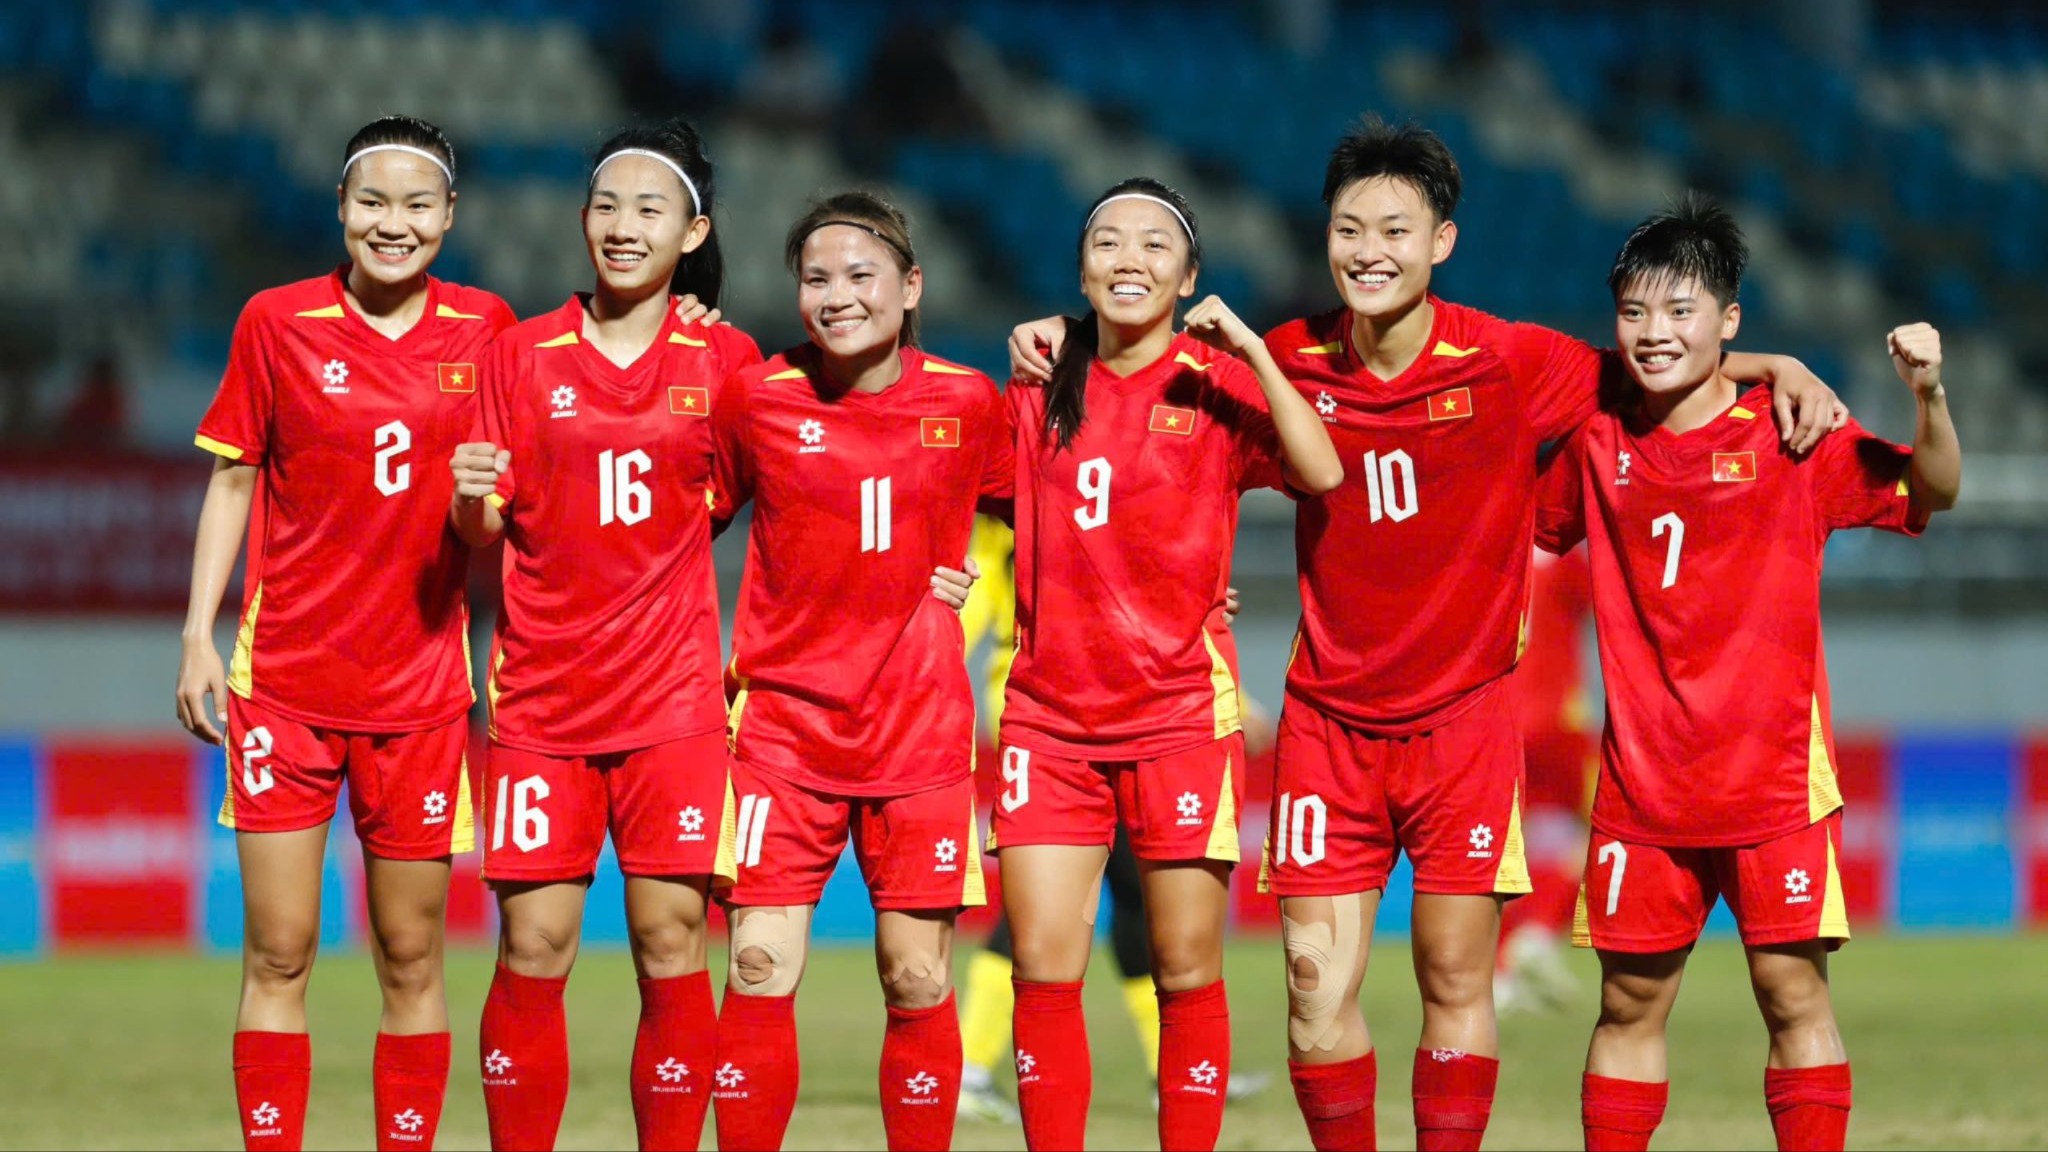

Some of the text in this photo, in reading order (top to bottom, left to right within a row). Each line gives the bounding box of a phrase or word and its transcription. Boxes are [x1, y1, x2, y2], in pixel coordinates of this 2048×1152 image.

[374, 419, 411, 497] 2
[598, 449, 652, 526] 16
[1073, 456, 1113, 531] 9
[1363, 449, 1419, 523] 10
[860, 476, 892, 553] 11
[1651, 512, 1685, 589] 7
[243, 726, 274, 797] 2
[1001, 745, 1031, 813] 9
[491, 774, 550, 852] 16
[736, 794, 772, 867] 11
[1275, 792, 1327, 868] 10
[1598, 840, 1628, 917] 7
